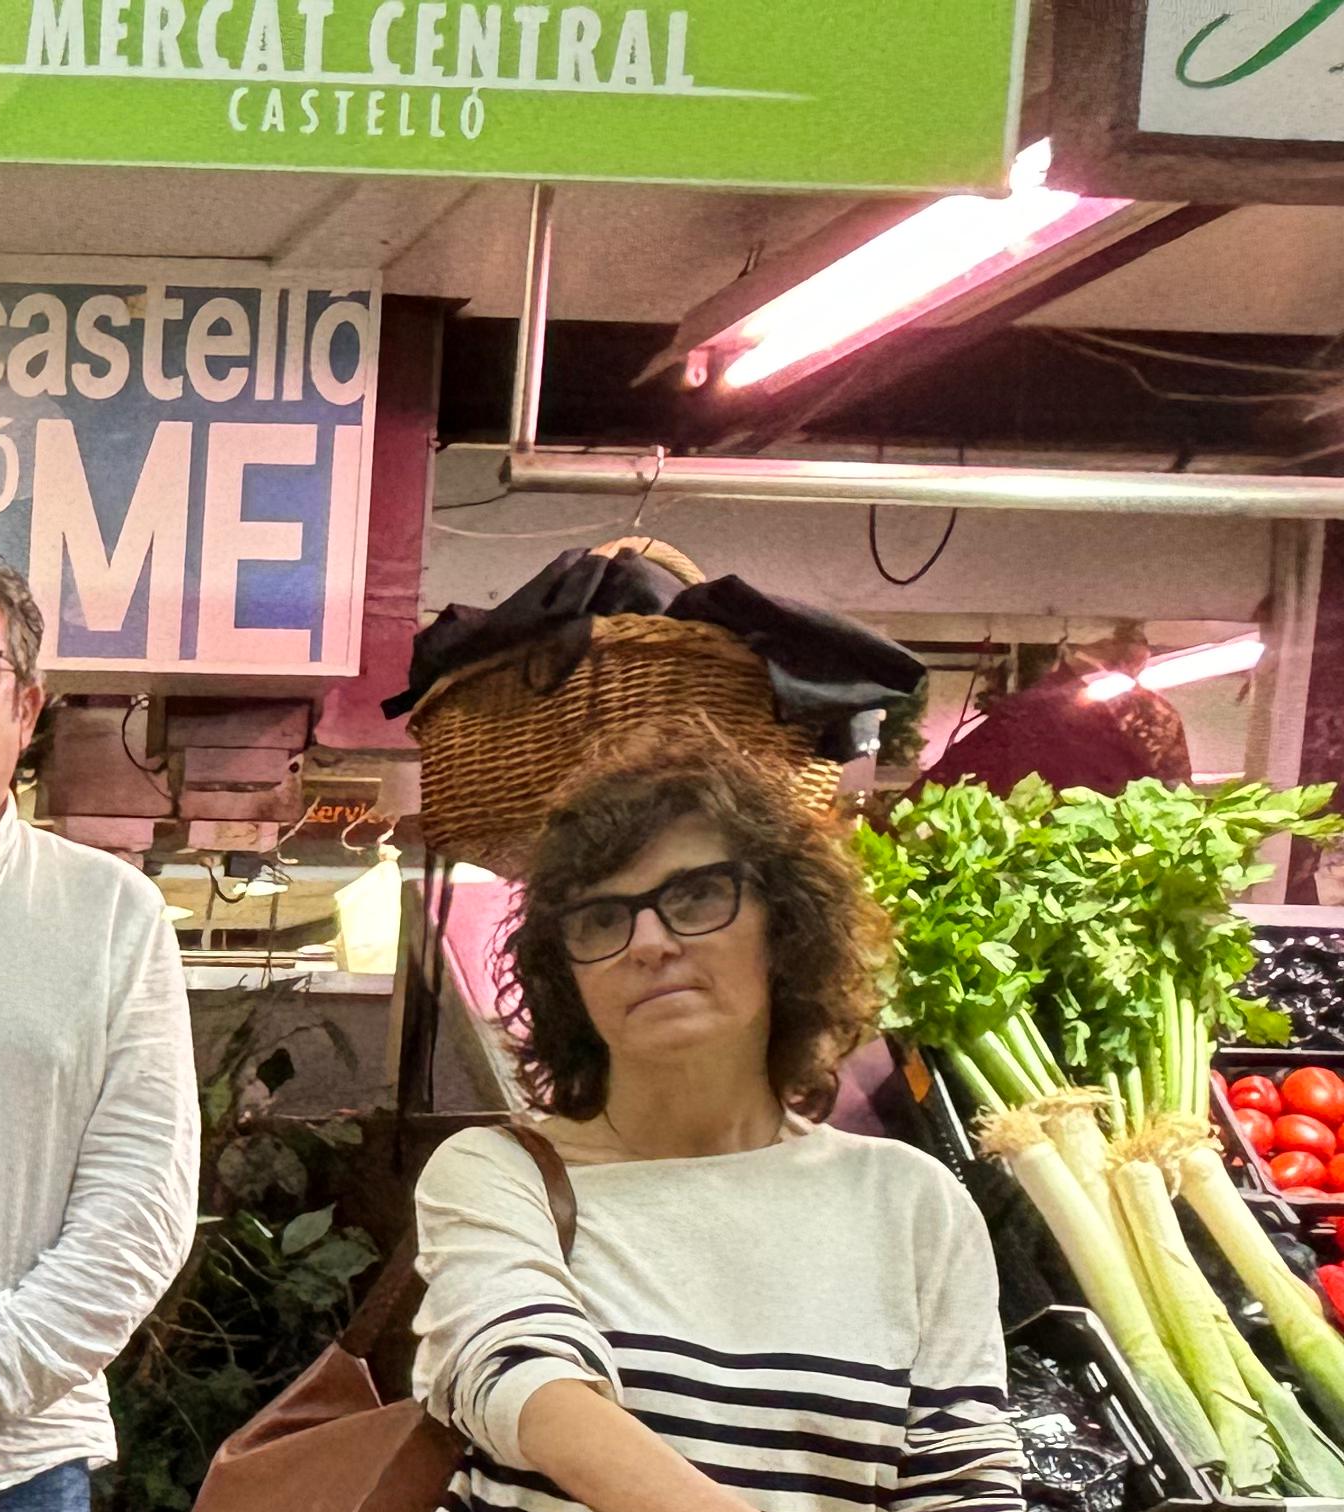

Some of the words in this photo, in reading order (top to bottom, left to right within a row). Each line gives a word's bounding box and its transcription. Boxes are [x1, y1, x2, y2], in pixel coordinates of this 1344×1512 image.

[24, 0, 326, 75] MERCAT
[370, 0, 696, 88] CENTRAL
[228, 85, 486, 140] CASTELLÓ
